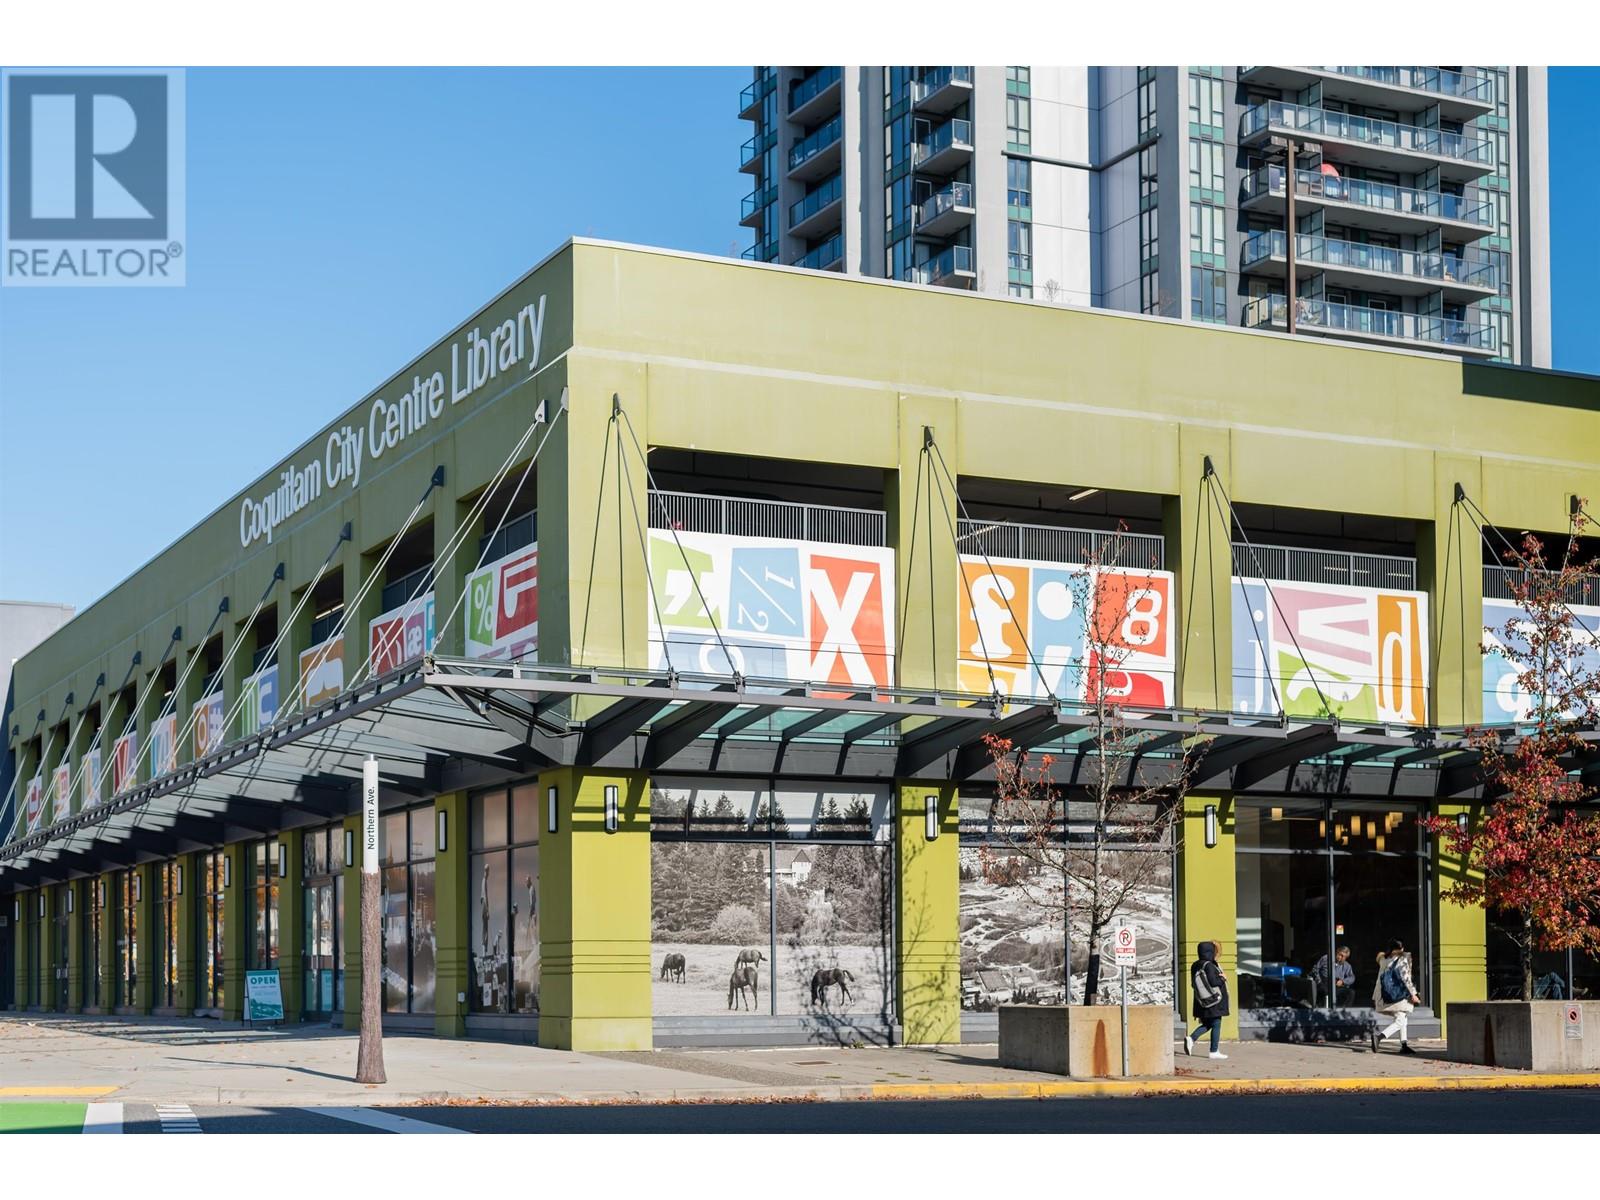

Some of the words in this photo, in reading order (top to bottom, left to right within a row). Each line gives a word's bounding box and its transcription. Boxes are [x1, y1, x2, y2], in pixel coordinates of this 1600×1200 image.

[240, 459, 322, 548] Coquitlam
[325, 425, 365, 488] City
[369, 371, 445, 459] Centre
[451, 294, 547, 405] Library
[1121, 588, 1163, 646] 8
[366, 786, 375, 806] Ave.
[366, 809, 375, 850] Northern
[250, 976, 276, 985] OPEN
